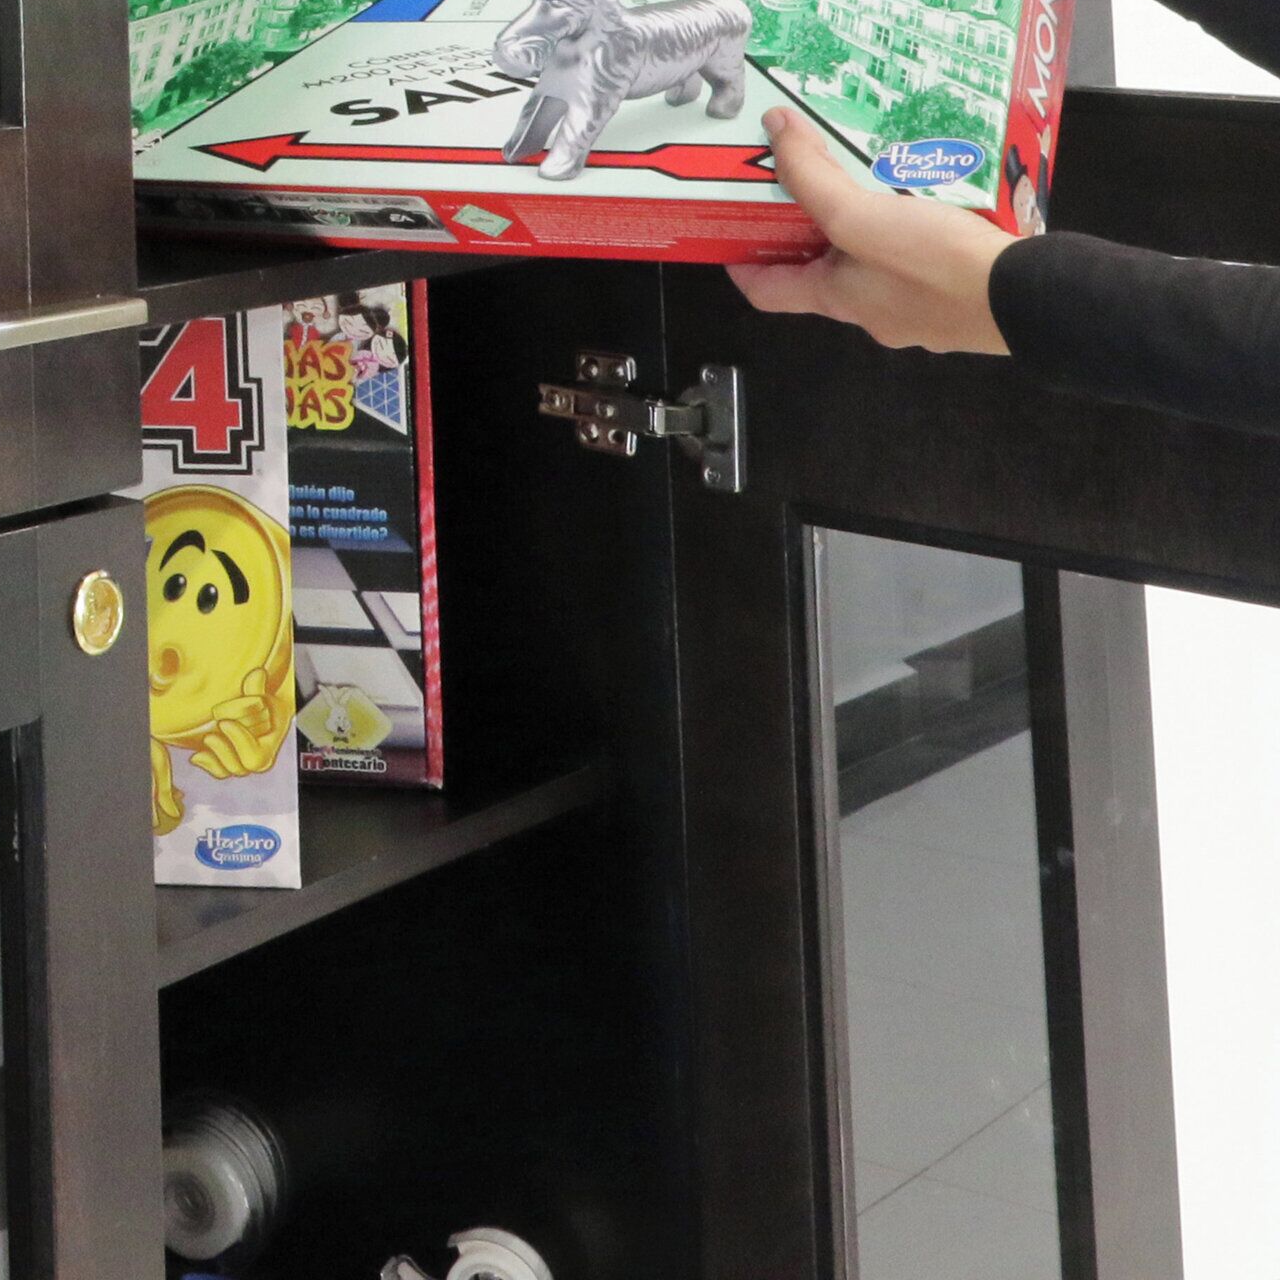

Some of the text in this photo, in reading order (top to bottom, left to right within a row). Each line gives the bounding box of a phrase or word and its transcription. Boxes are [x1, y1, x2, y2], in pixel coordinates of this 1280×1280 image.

[878, 145, 975, 170] Hasbro
[893, 166, 955, 182] Gaming
[139, 318, 241, 453] 4
[306, 505, 320, 519] lo
[322, 506, 388, 522] cuadrado
[299, 525, 316, 537] es
[318, 524, 389, 540] divertido?
[198, 828, 274, 853] Hasbro
